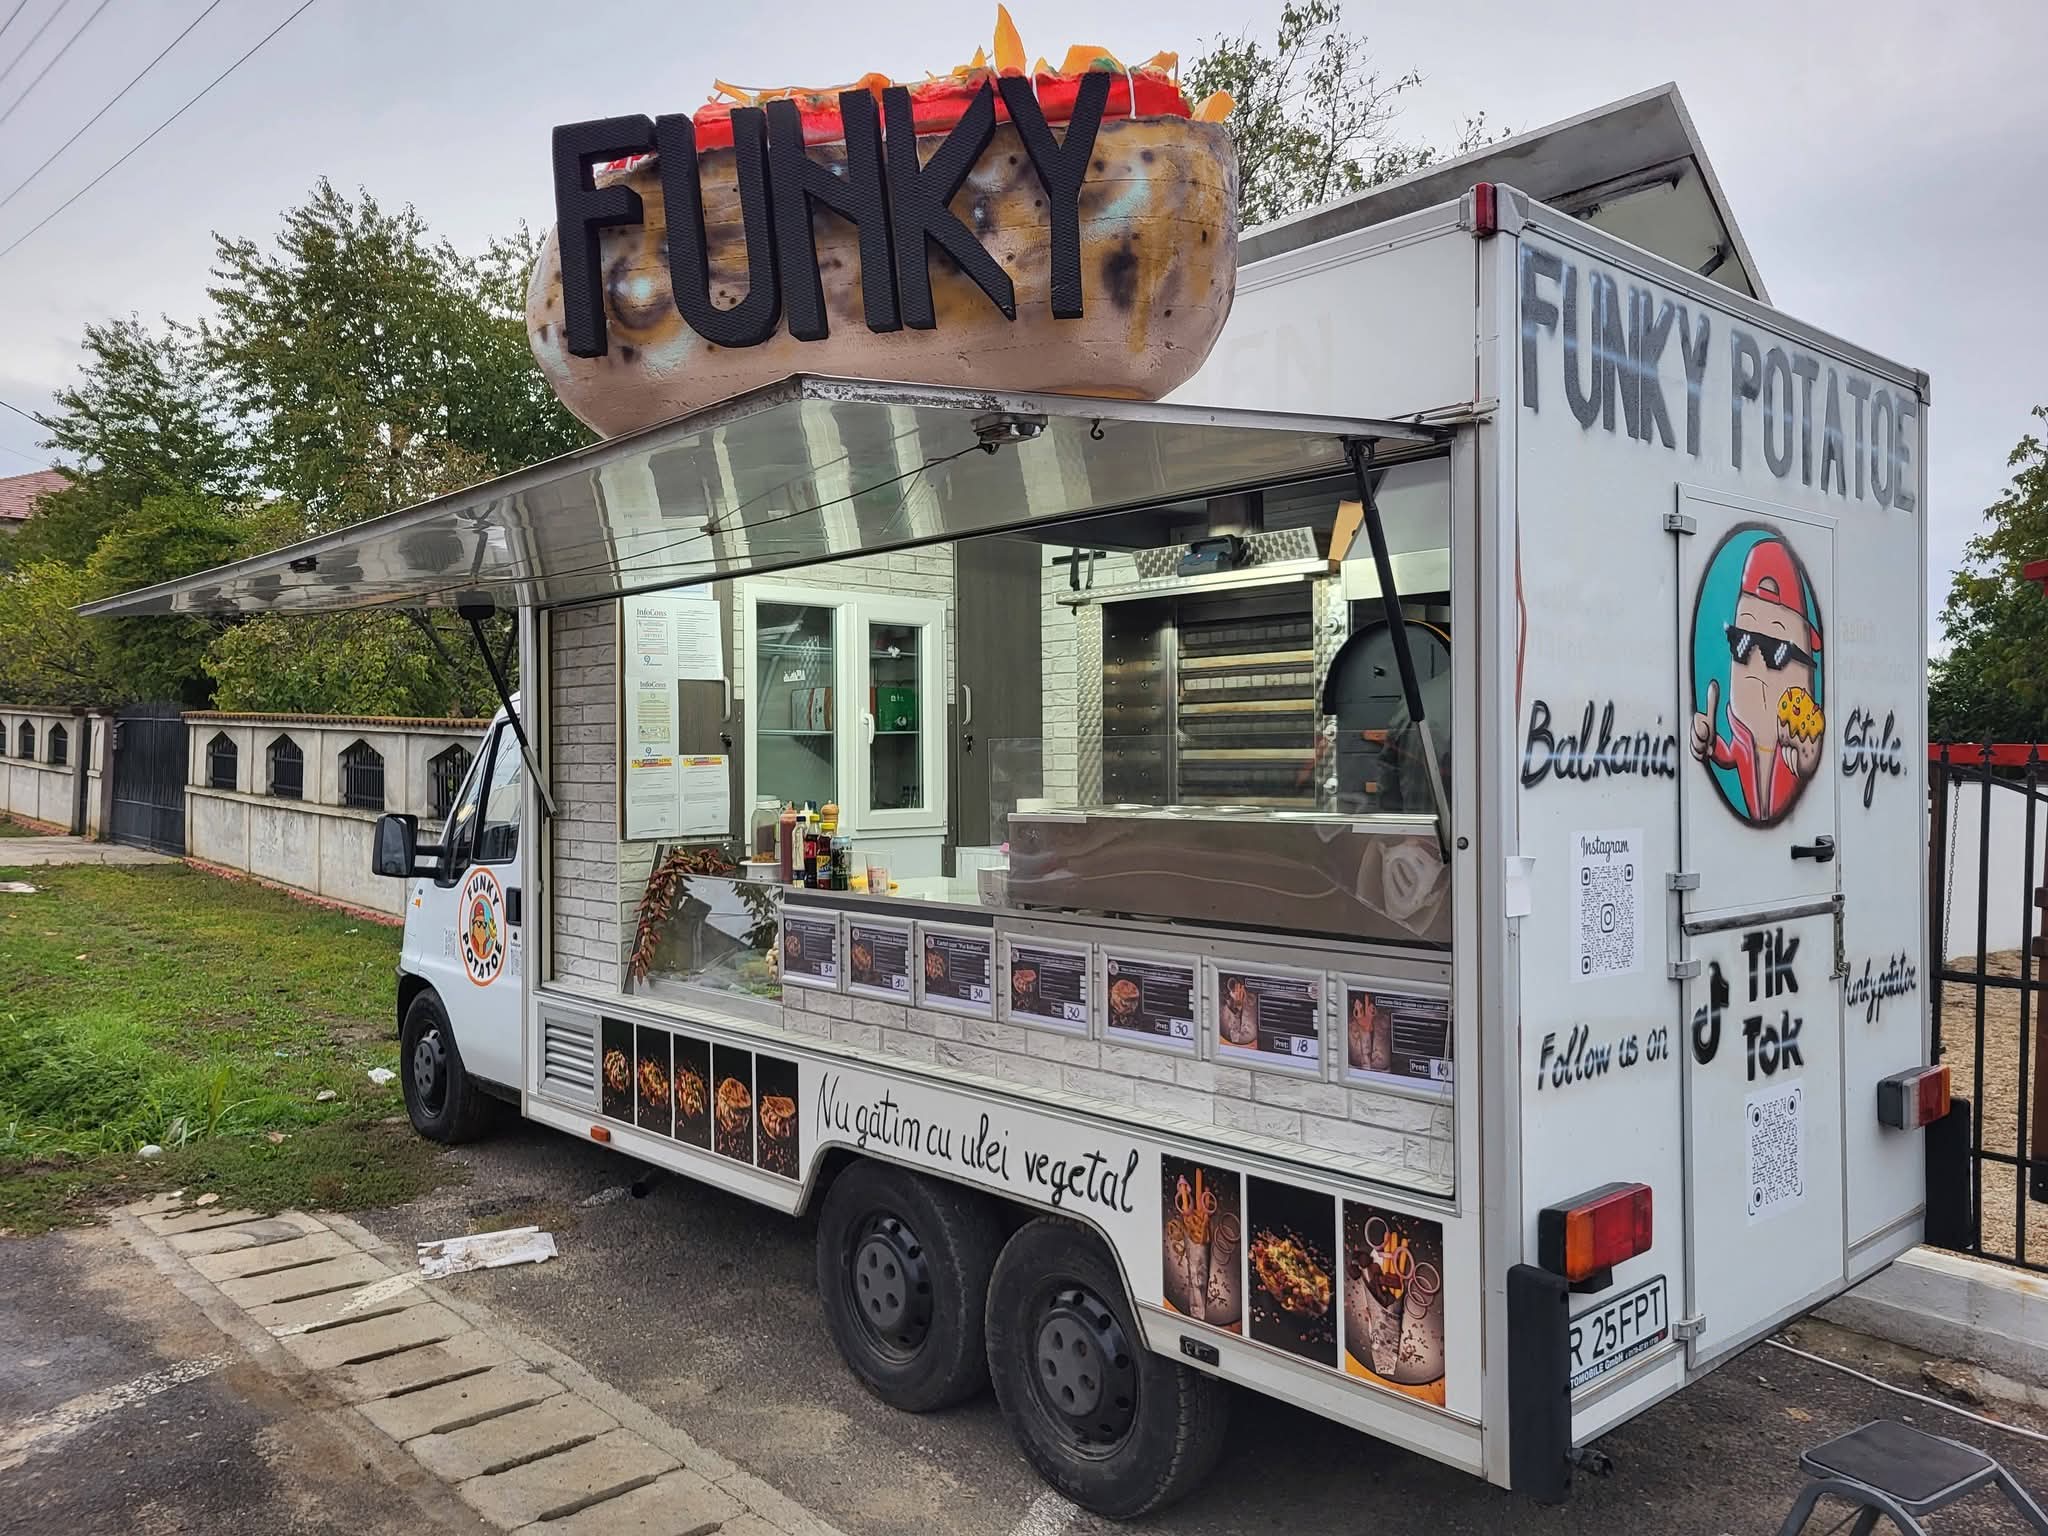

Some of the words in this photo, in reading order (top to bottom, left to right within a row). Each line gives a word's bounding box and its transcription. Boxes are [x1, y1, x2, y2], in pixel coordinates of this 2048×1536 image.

[552, 71, 1111, 359] FUNKY
[1520, 242, 1711, 456] FUNKY
[1730, 328, 1917, 513] POTATOE
[1521, 700, 1676, 789] Balkanic
[1581, 835, 1629, 863] Instagram
[467, 874, 500, 907] FUNKY
[462, 932, 502, 979] POTATOE
[974, 988, 983, 999] 30
[1067, 1006, 1080, 1020] 30
[1175, 1021, 1188, 1036] 30
[1297, 1039, 1308, 1052] 18
[1537, 1024, 1612, 1091] Follow
[1618, 1034, 1639, 1068] us
[1646, 1025, 1669, 1062] on
[816, 1072, 850, 1140] Nu
[926, 1123, 952, 1161] cu
[961, 1112, 1010, 1181] ulei
[1024, 1148, 1139, 1214] vegetal
